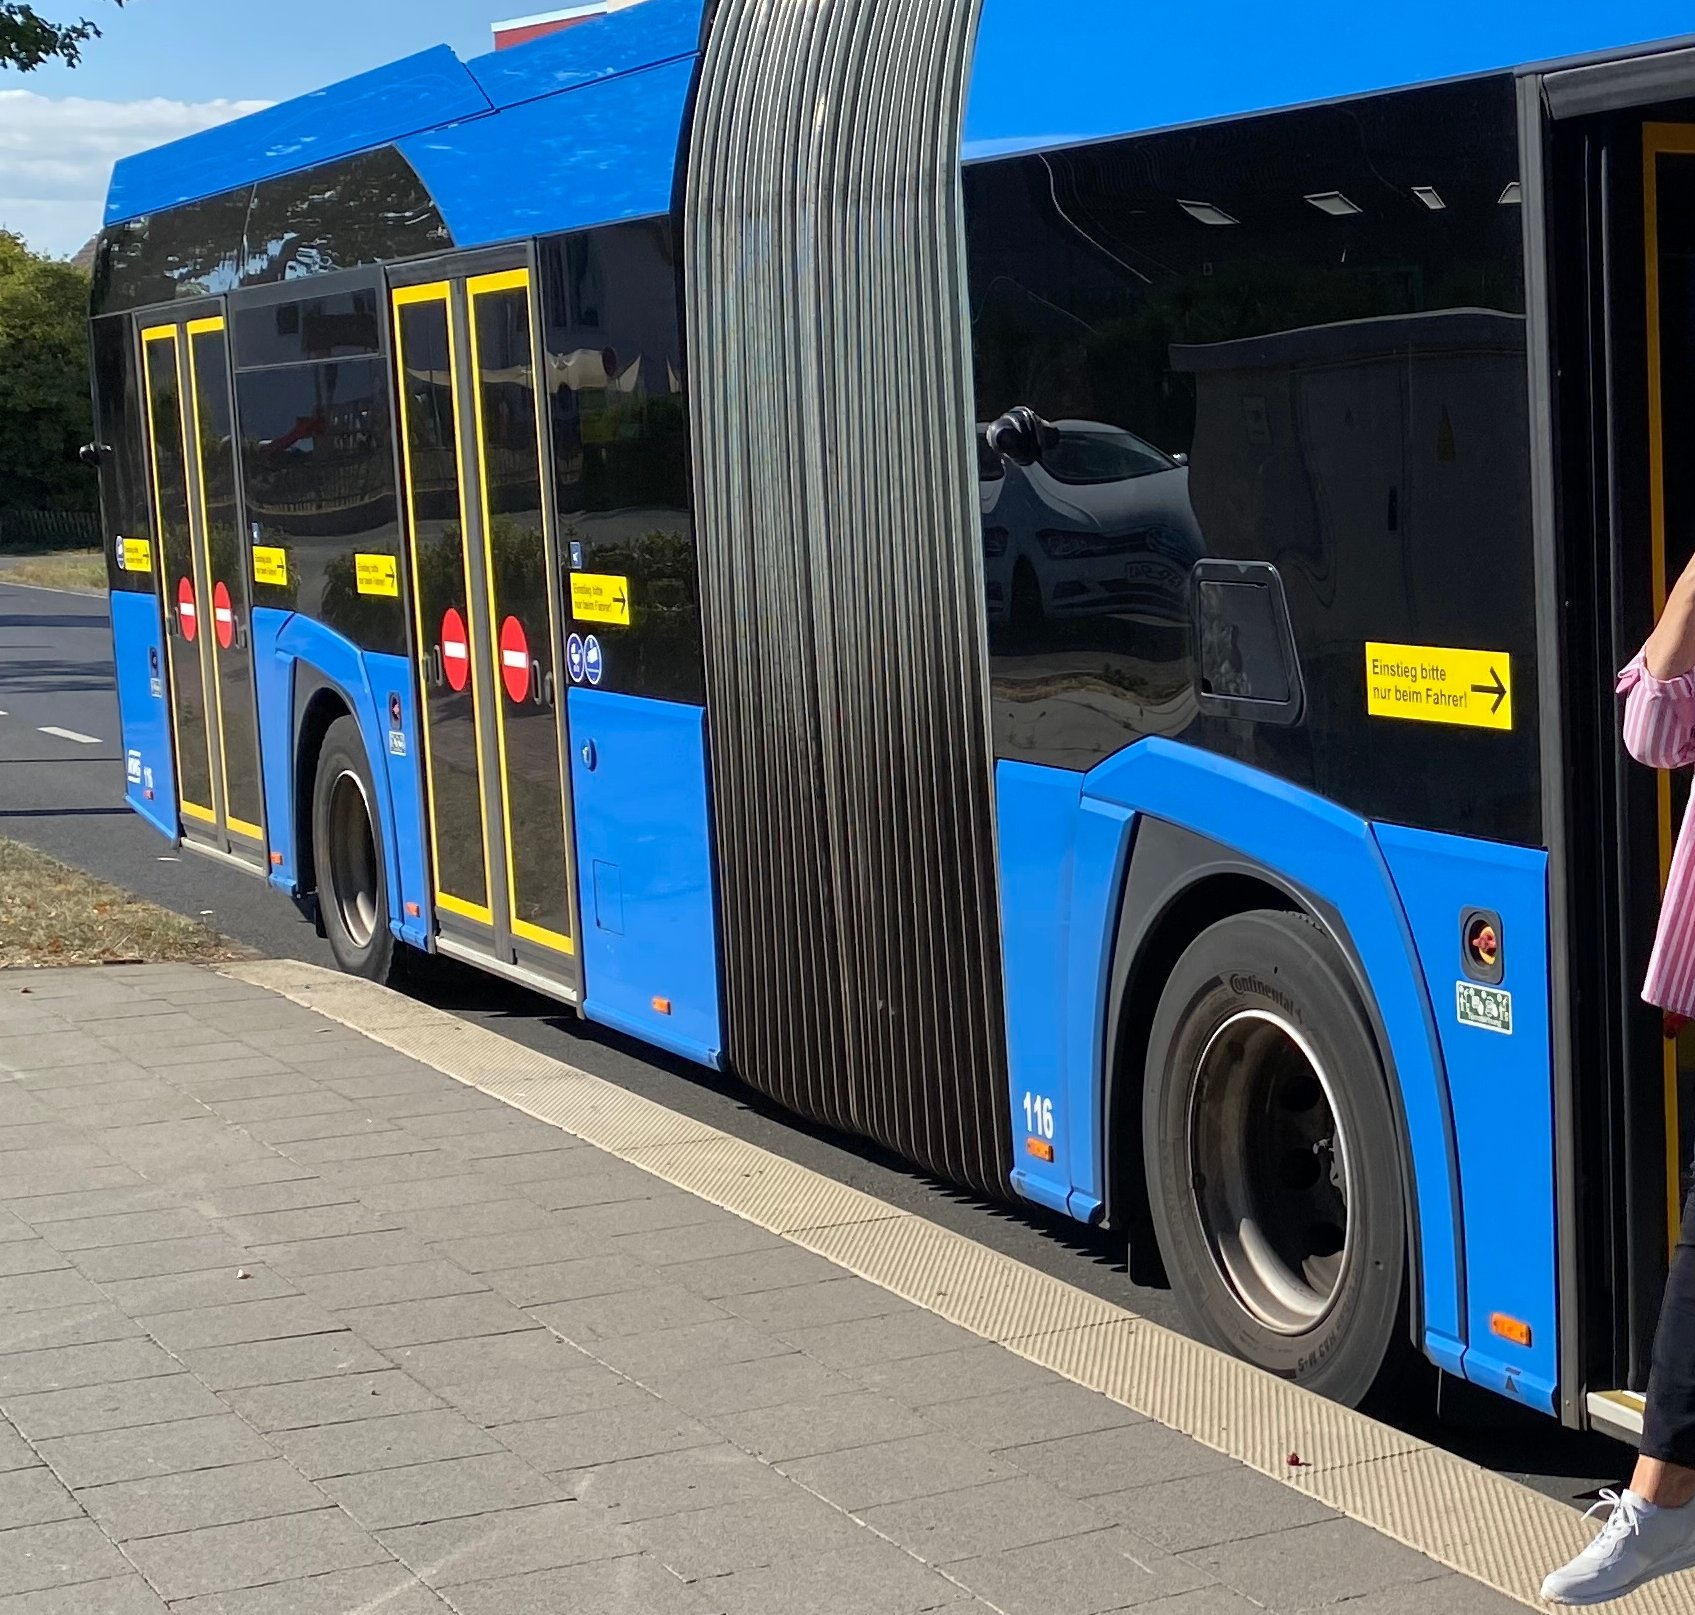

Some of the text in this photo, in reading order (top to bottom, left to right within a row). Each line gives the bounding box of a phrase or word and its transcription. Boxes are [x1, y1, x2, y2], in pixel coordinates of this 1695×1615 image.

[1372, 658, 1447, 682] Einstieg bitte
[1373, 685, 1468, 709] nur beim Fahrer!
[1229, 973, 1295, 1017] Continental
[1023, 1090, 1054, 1140] 116
